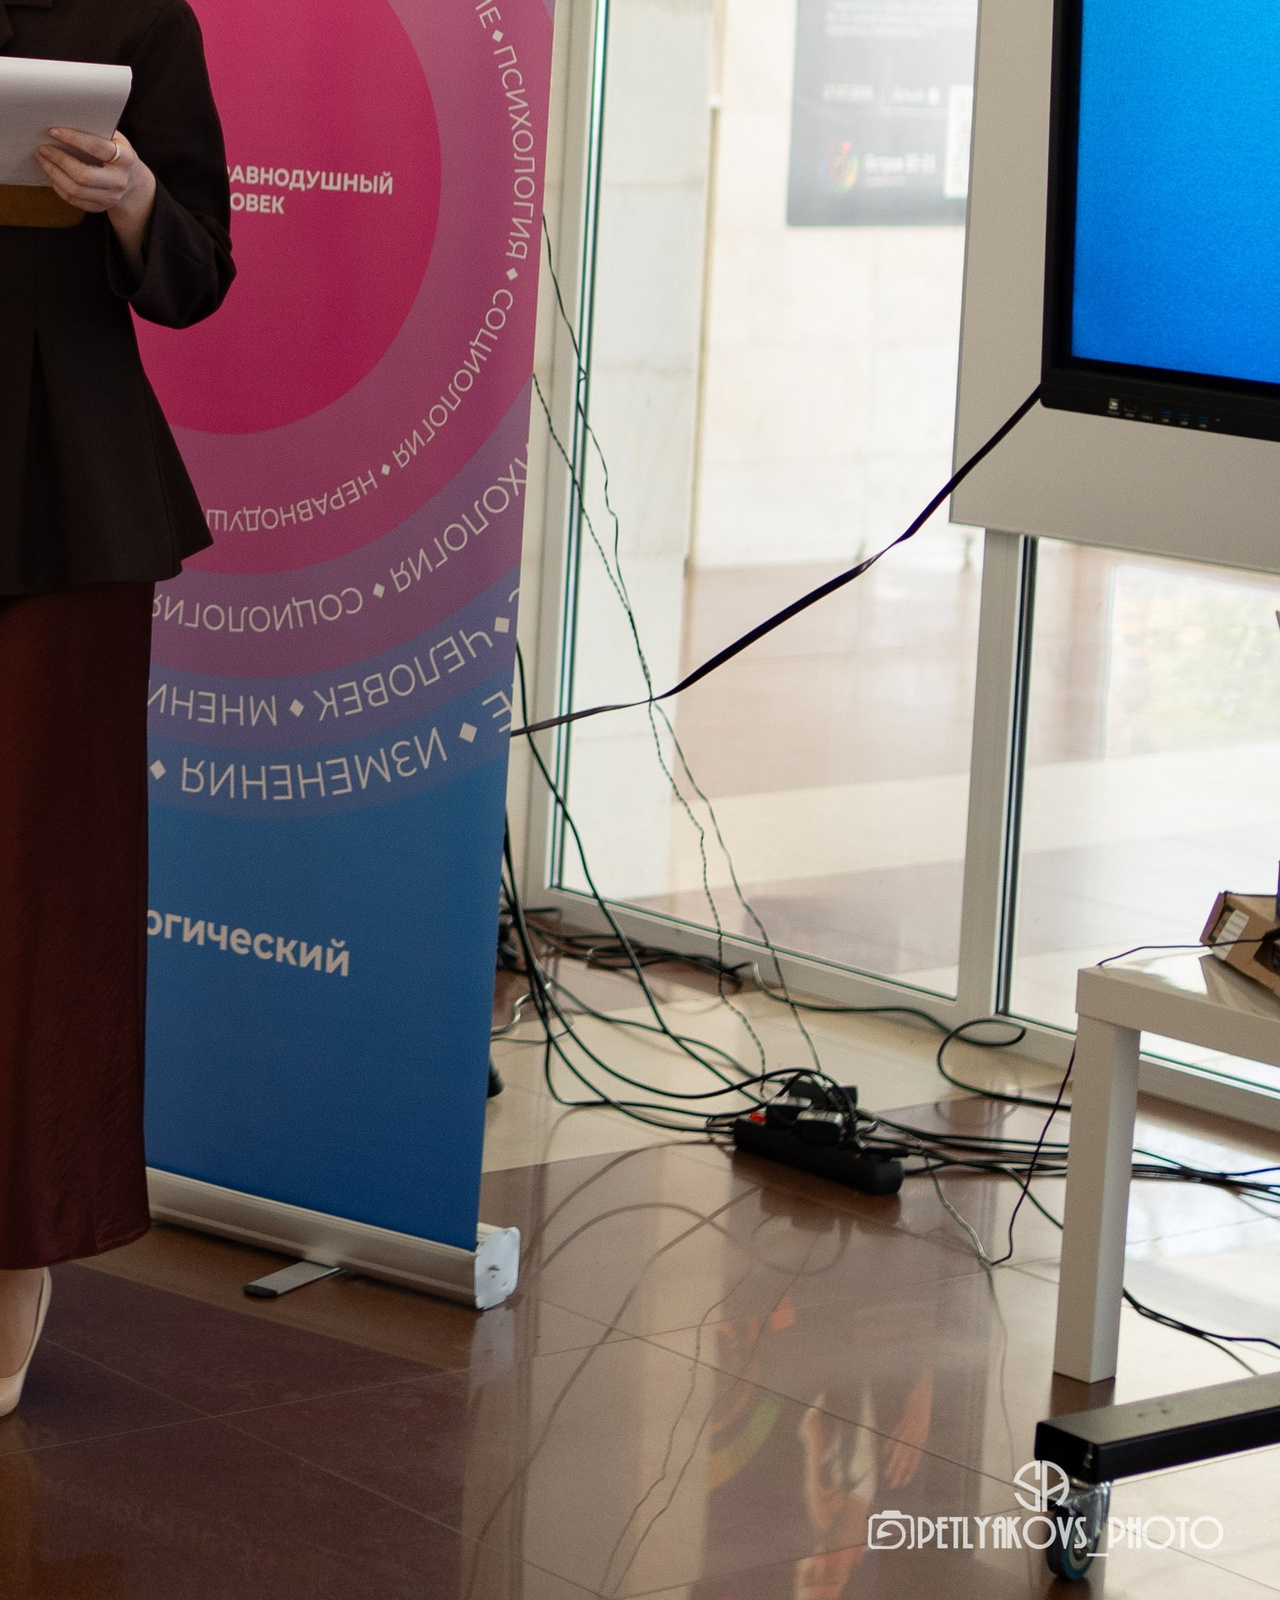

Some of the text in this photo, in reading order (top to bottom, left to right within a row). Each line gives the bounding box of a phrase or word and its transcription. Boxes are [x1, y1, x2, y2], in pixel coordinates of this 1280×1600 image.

[227, 164, 394, 196] АВНОДУШНЫЙ
[493, 45, 536, 260] ПСИХОЛОГИЯ
[229, 192, 286, 215] ОВЕК
[392, 288, 514, 469] СОЦИОЛОГИЯ
[312, 629, 494, 722] ЧЕЛОВЕК
[181, 726, 448, 801] ИЗМЕНЕНИЯ
